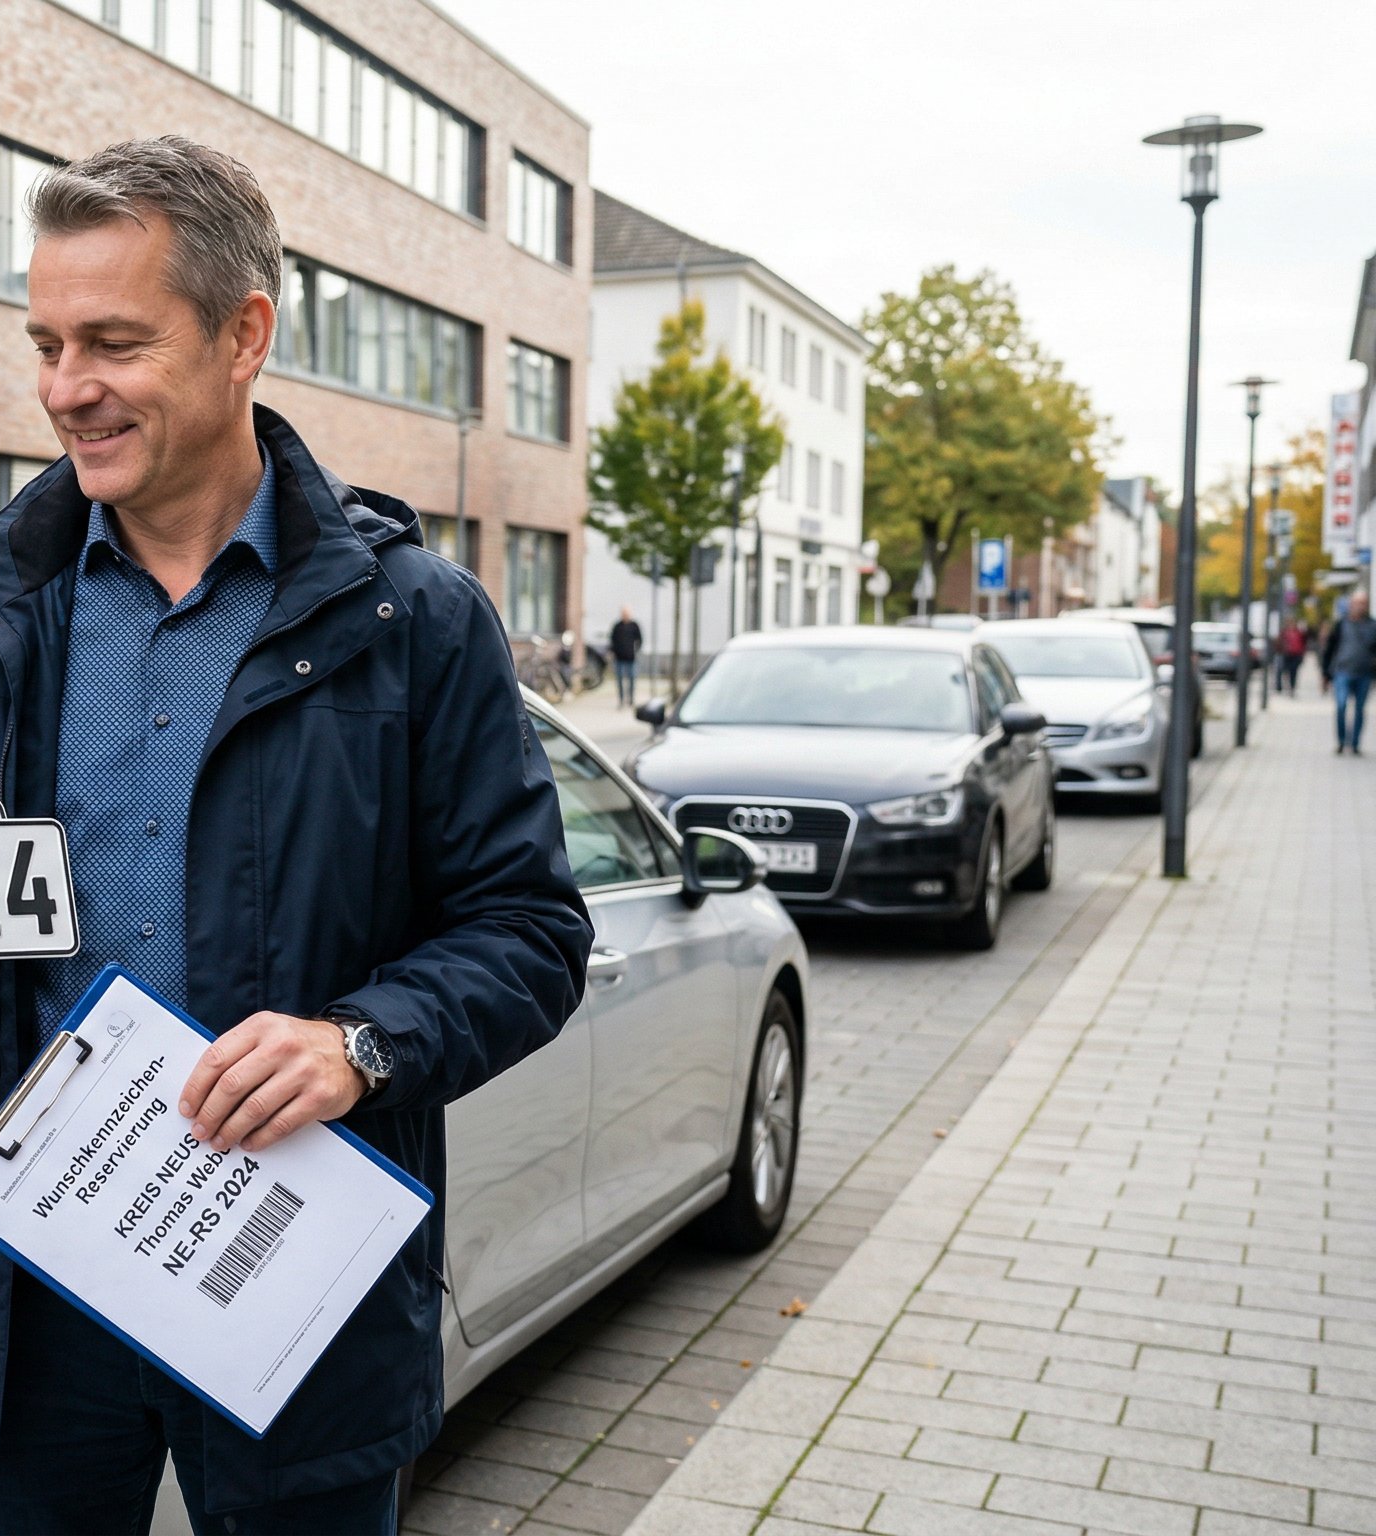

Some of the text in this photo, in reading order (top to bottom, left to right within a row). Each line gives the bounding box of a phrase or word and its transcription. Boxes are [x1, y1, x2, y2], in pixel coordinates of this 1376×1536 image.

[32, 1055, 165, 1219] Wunschkennzeichen-
[75, 1097, 168, 1205] Reservierung
[114, 1132, 200, 1239] KREIS NEUS
[133, 1191, 193, 1257] Thomas
[162, 1155, 260, 1277] NE-RS 2024
